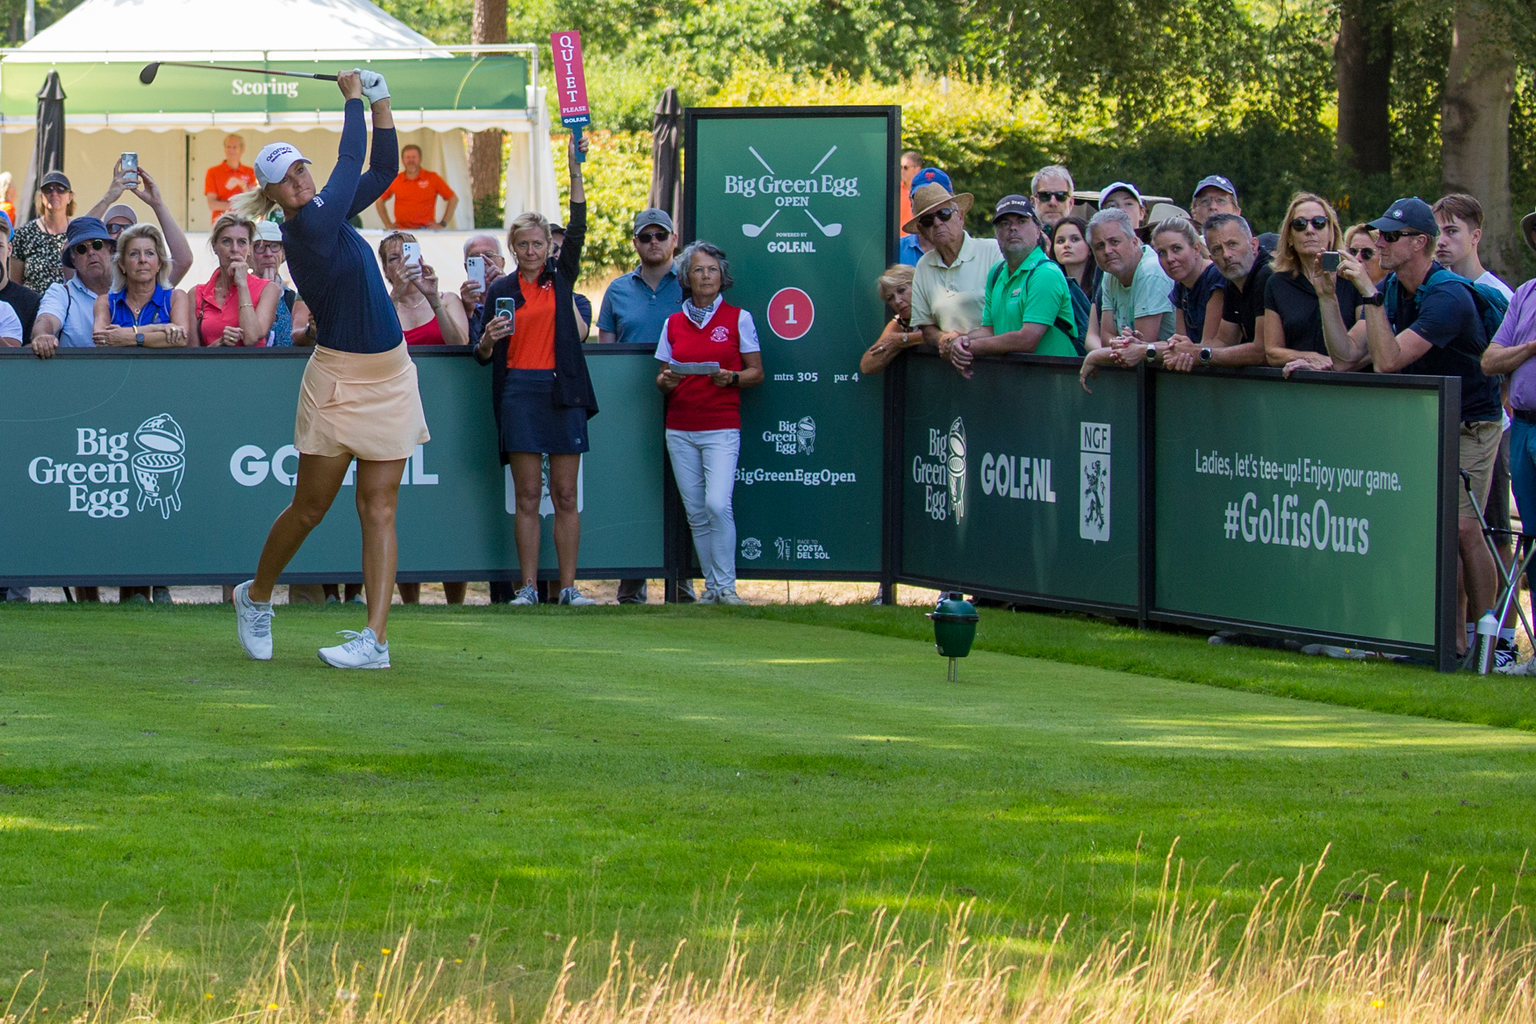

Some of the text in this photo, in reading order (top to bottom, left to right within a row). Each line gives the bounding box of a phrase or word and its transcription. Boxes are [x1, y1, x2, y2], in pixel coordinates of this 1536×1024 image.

[559, 35, 578, 103] QUIET
[232, 77, 299, 98] Scoring
[563, 105, 587, 114] PLEASE
[724, 175, 858, 198] Big Green Egg
[775, 196, 809, 207] OPEN
[767, 241, 816, 253] GOLF.NL
[784, 303, 798, 325] 1
[774, 372, 818, 382] mtrs 305
[834, 372, 859, 384] par 4
[762, 431, 797, 442] Green
[779, 421, 797, 433] Big
[1084, 426, 1108, 449] NGF
[76, 427, 129, 462] Big
[776, 442, 797, 454] Egg
[929, 428, 947, 464] Big
[28, 456, 130, 484] Green
[913, 455, 947, 485] Green
[980, 452, 1057, 503] GOLF.NL
[1195, 448, 1402, 495] Ladies, let's tee-up! Enjoy your game.
[68, 484, 130, 518] Egg
[925, 485, 946, 520] Egg
[1224, 491, 1369, 555] #GolfisOurs
[814, 552, 830, 560] SOL
